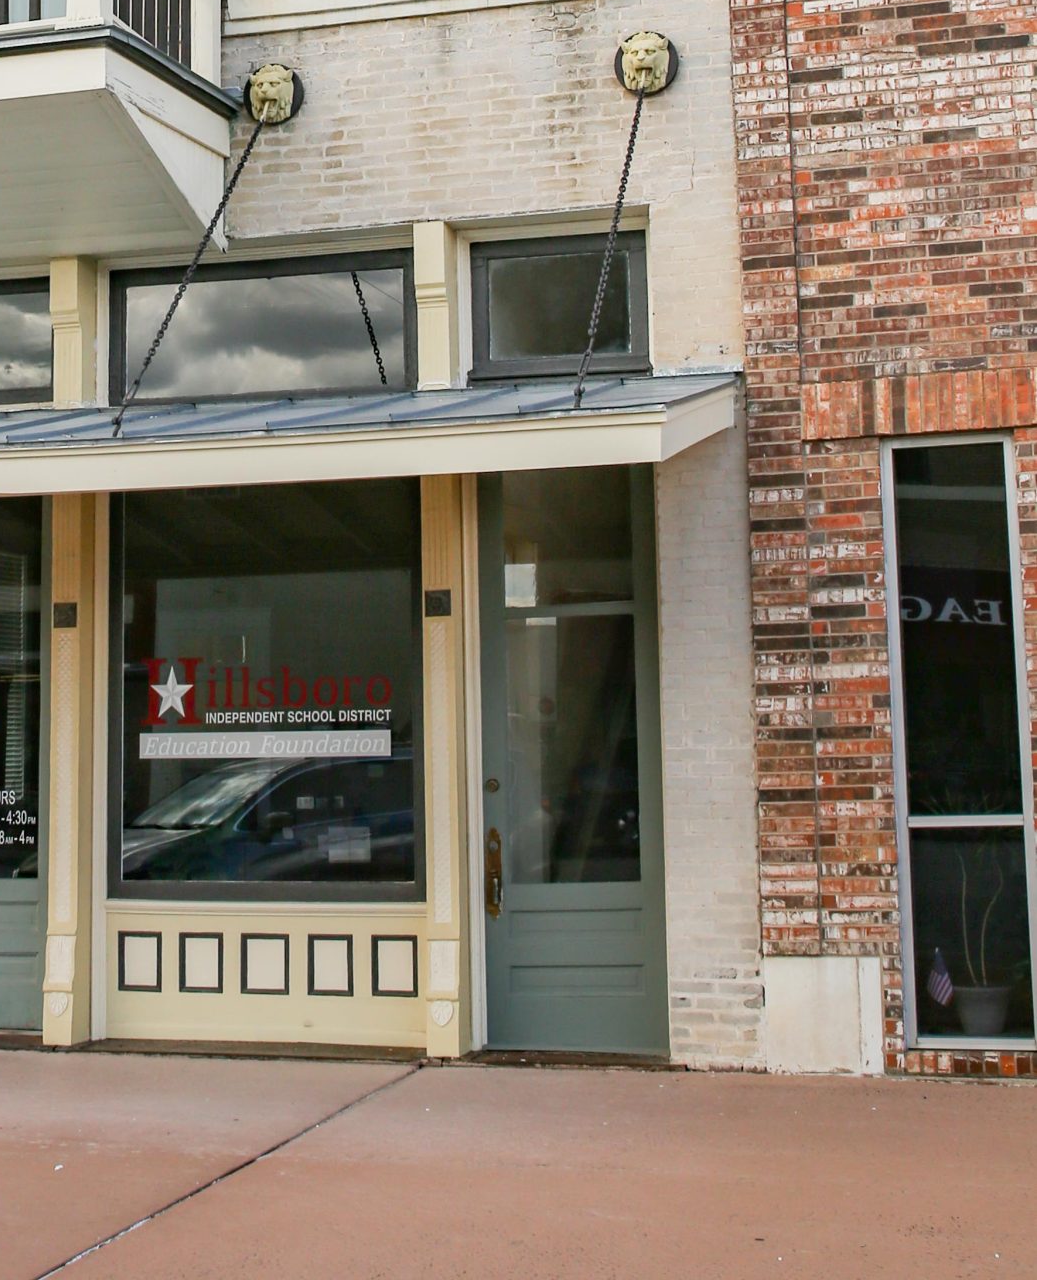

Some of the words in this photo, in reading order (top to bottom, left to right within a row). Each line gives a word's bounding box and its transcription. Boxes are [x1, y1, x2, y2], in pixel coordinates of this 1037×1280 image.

[141, 657, 393, 727] Hillsboro
[205, 711, 285, 725] INDEPENDENT
[287, 710, 336, 723] SCHOOL
[338, 709, 392, 722] DISTRICT
[144, 735, 251, 757] Education
[259, 733, 385, 755] Foundation
